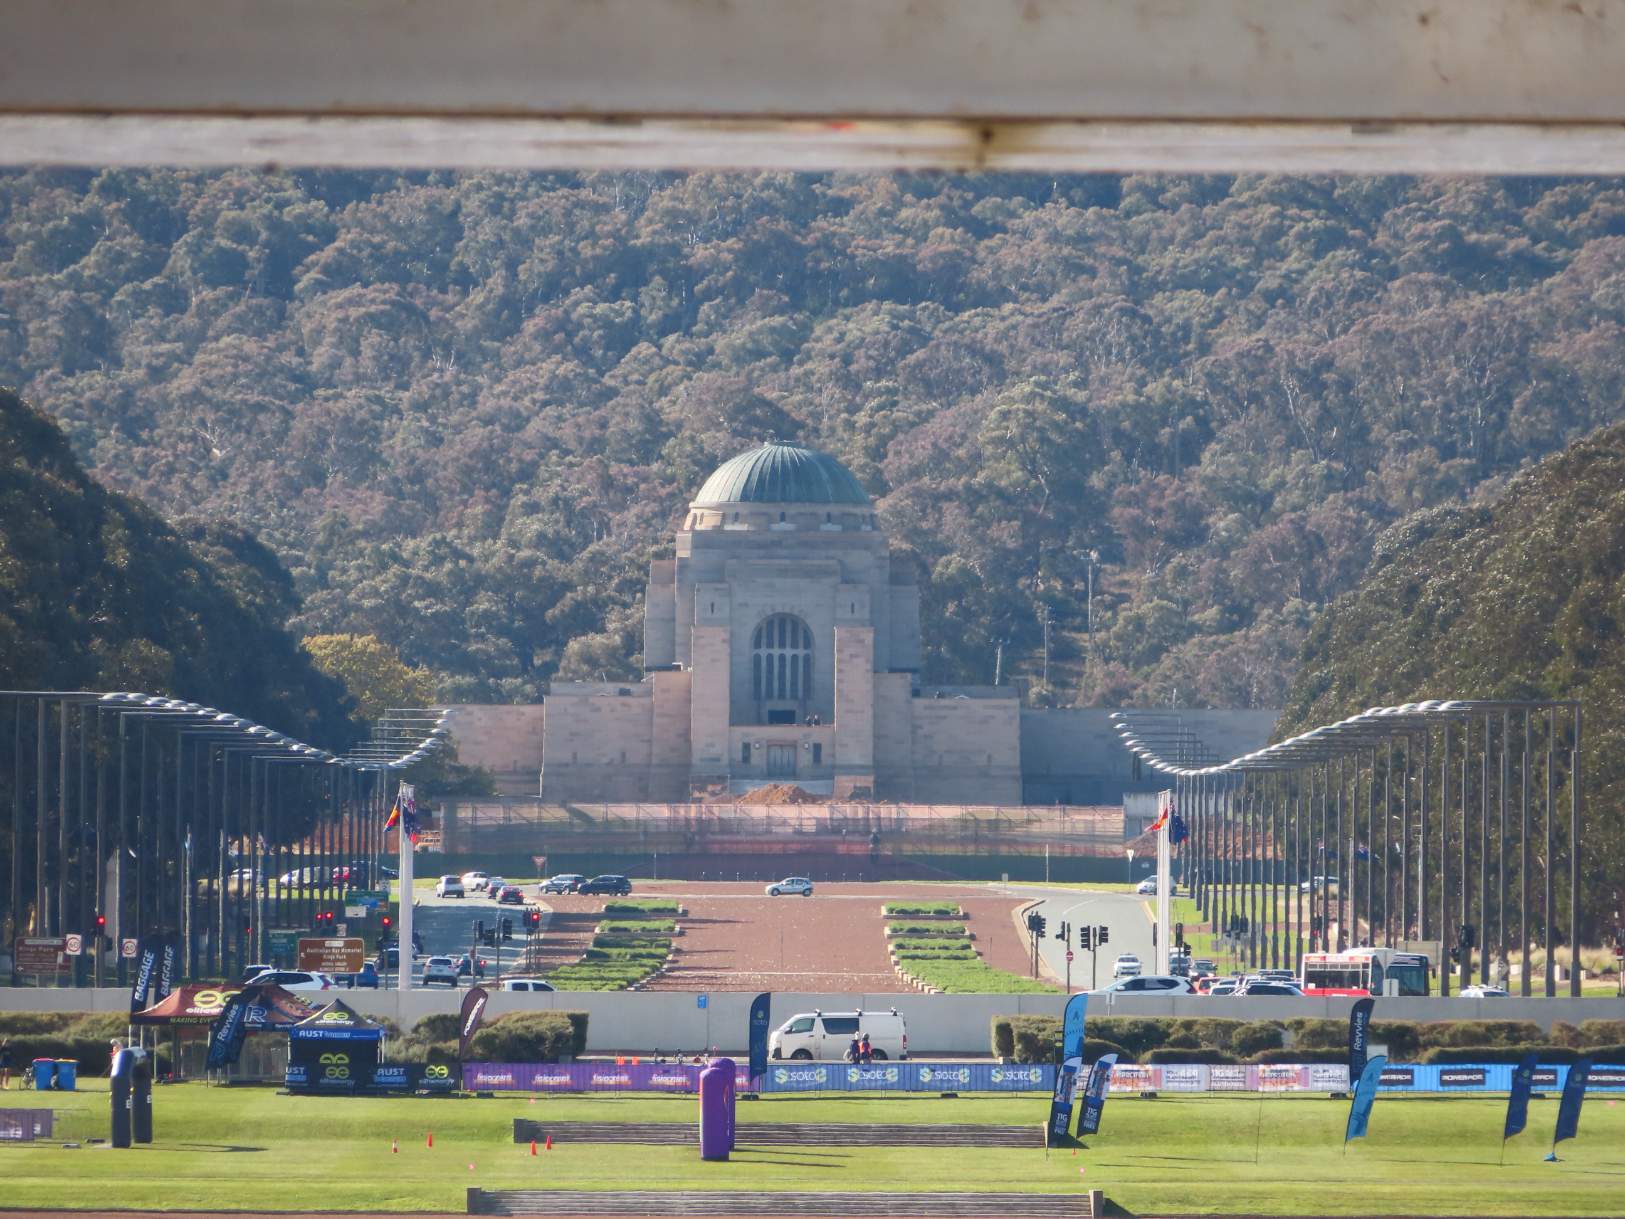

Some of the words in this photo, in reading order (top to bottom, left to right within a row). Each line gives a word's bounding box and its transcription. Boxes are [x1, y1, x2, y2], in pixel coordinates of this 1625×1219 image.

[134, 951, 154, 1002] BAGGAGE
[160, 945, 175, 997] BAGGAGE
[217, 1004, 239, 1041] Revvies
[299, 1030, 323, 1038] AUST
[1354, 1012, 1364, 1051] Revvies
[377, 1067, 404, 1076] AUST
